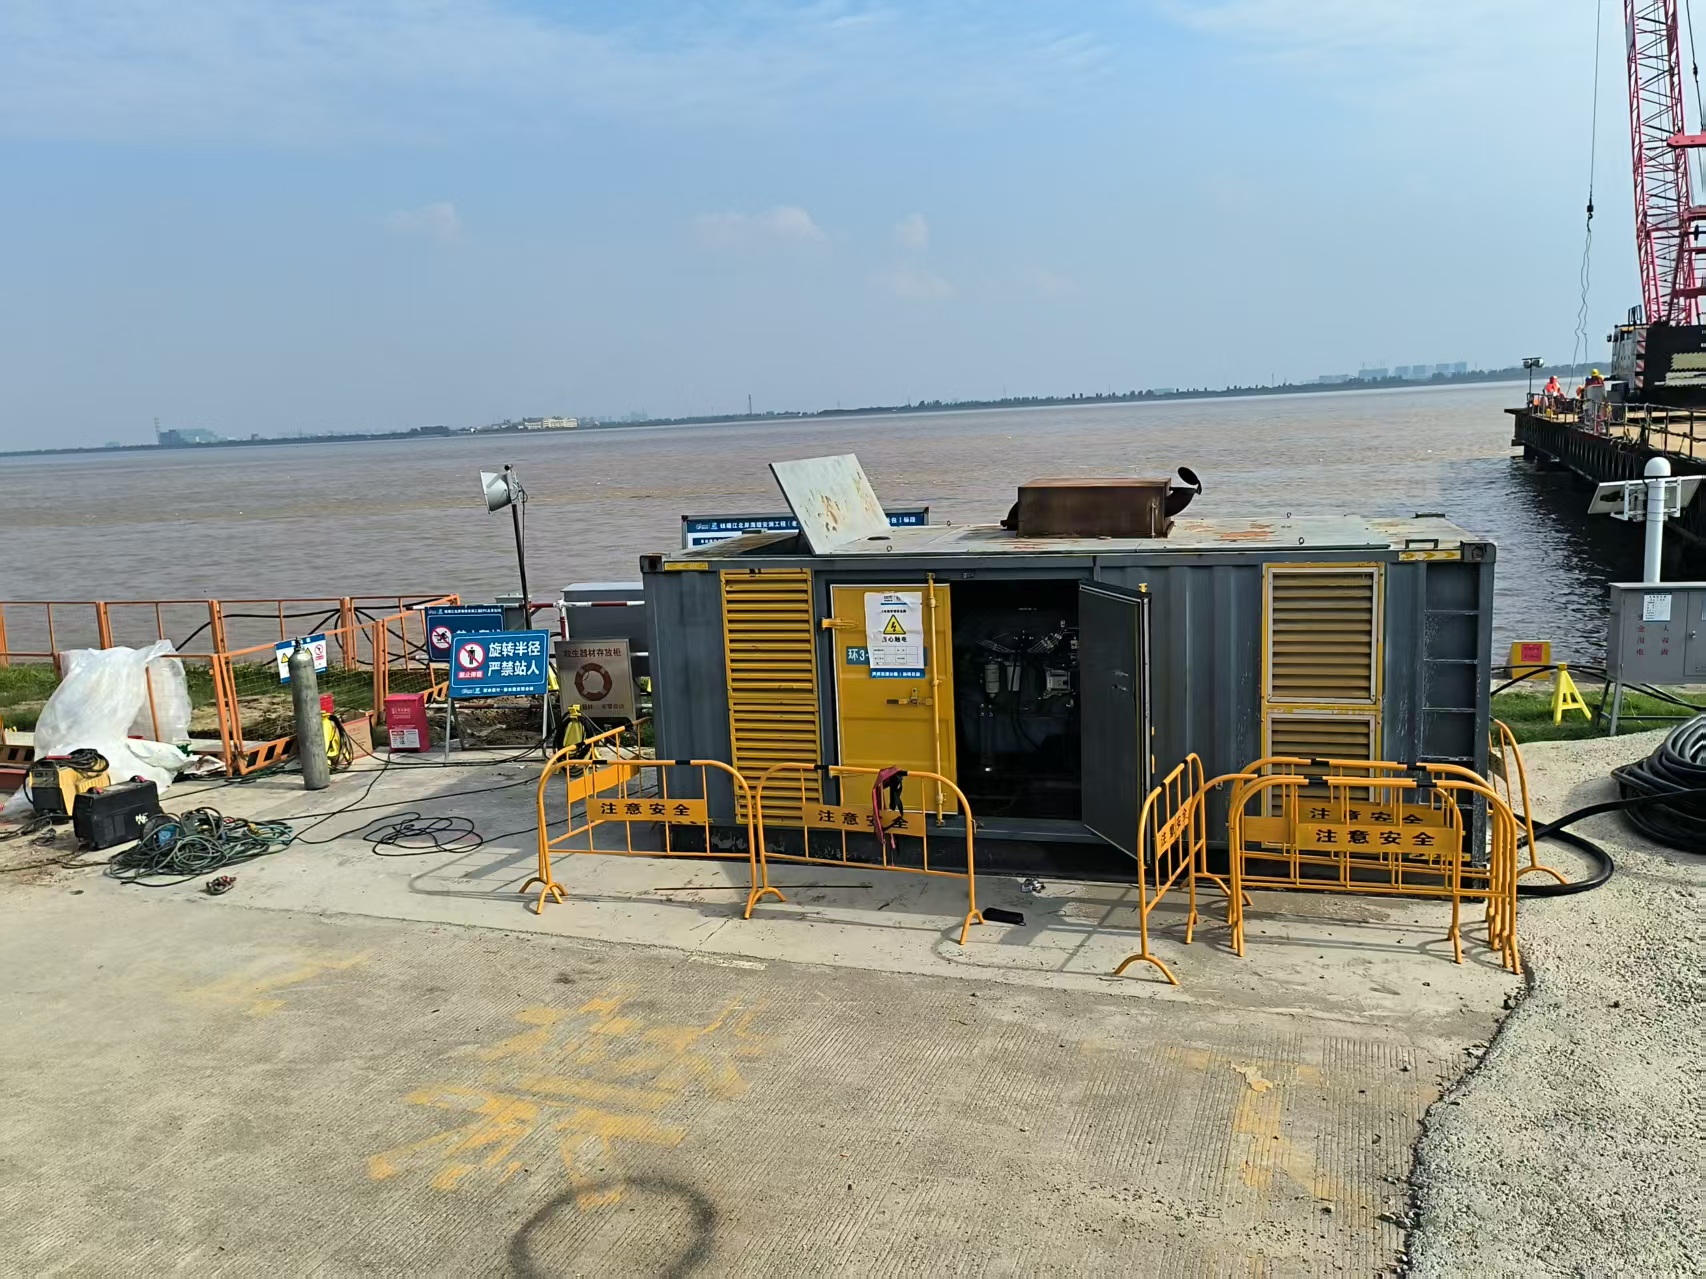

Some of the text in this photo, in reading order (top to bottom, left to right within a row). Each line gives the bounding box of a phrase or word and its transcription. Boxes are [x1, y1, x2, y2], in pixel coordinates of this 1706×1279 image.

[488, 640, 541, 658] 旋转半径
[487, 660, 540, 677] 严禁站人
[600, 802, 691, 816] 注意安全
[1309, 807, 1424, 825] 注意安全
[1315, 828, 1436, 847] 注意安全
